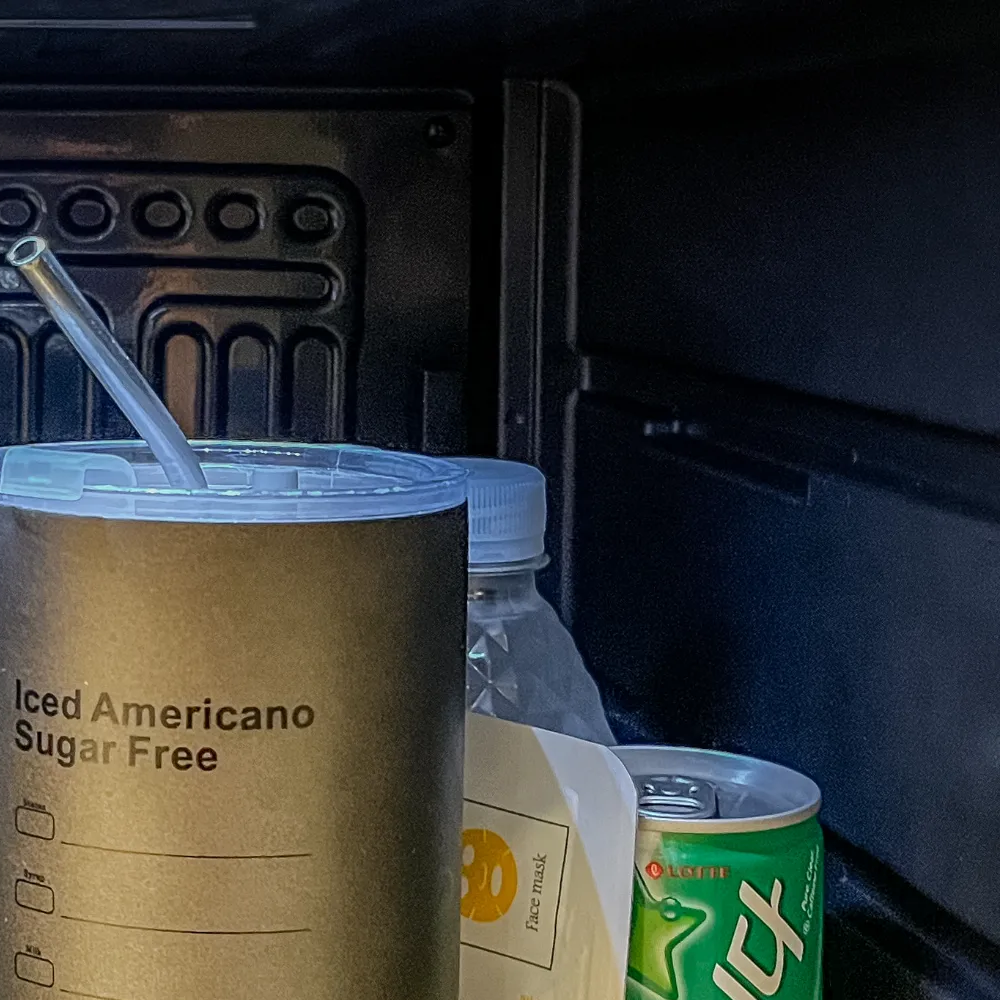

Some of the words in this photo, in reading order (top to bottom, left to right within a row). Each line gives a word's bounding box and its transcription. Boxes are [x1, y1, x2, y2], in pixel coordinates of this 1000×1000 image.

[15, 678, 81, 720] Iced
[91, 690, 315, 731] Americano
[14, 719, 117, 768] Sugar
[128, 735, 219, 772] Free
[532, 851, 548, 895] mask
[667, 864, 730, 879] LOTTE
[525, 897, 540, 932] Face
